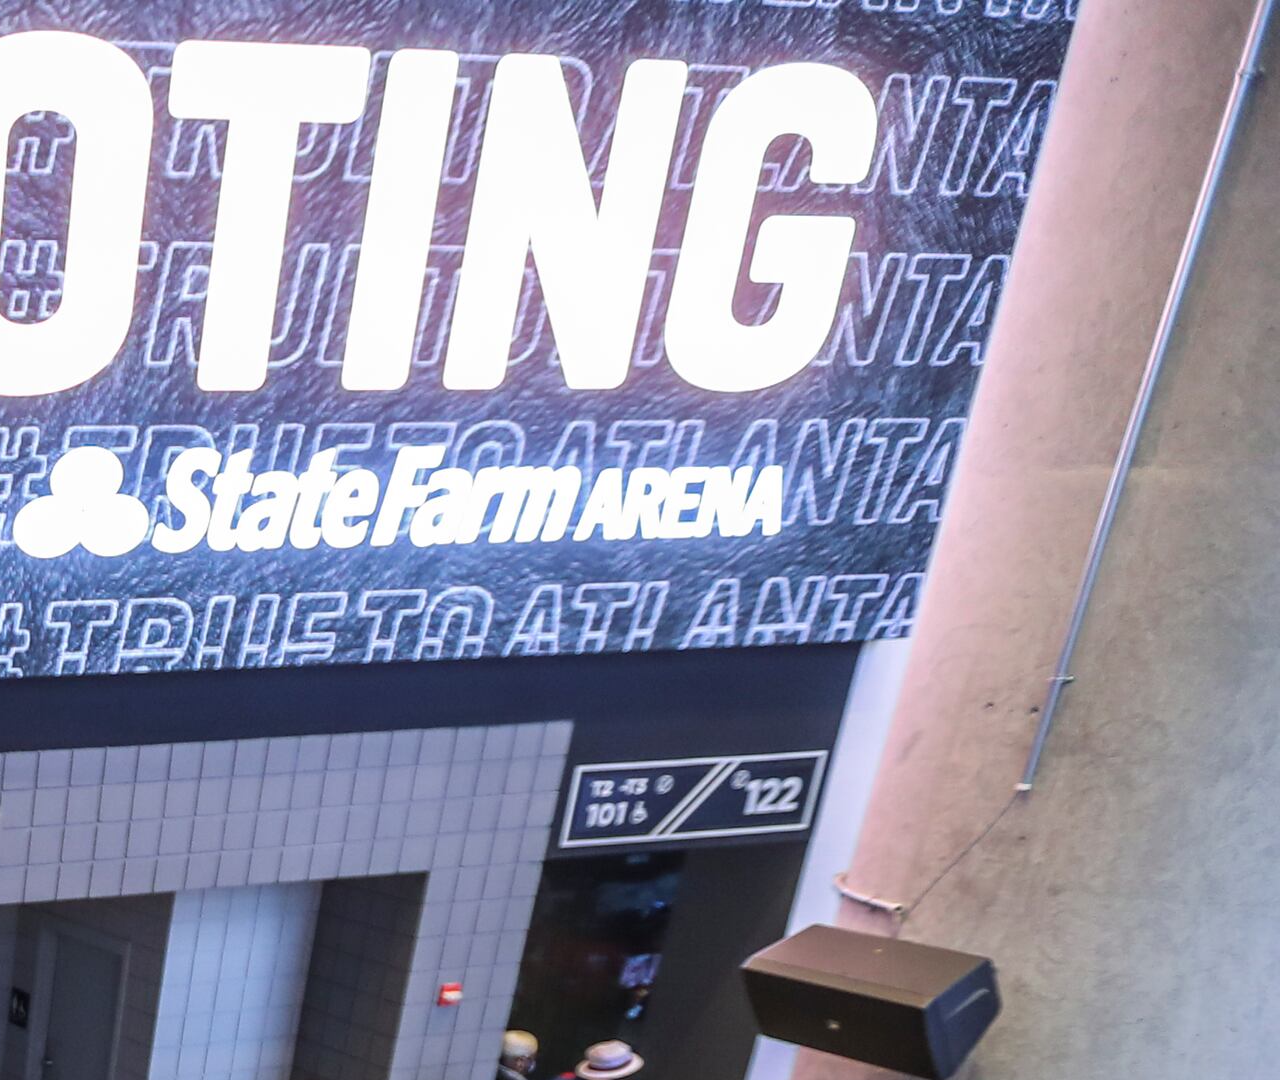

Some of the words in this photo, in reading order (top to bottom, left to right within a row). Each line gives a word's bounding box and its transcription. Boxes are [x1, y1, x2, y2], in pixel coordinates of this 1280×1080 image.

[574, 465, 783, 541] ARENA
[585, 801, 629, 828] 101
[743, 776, 803, 815] 122
